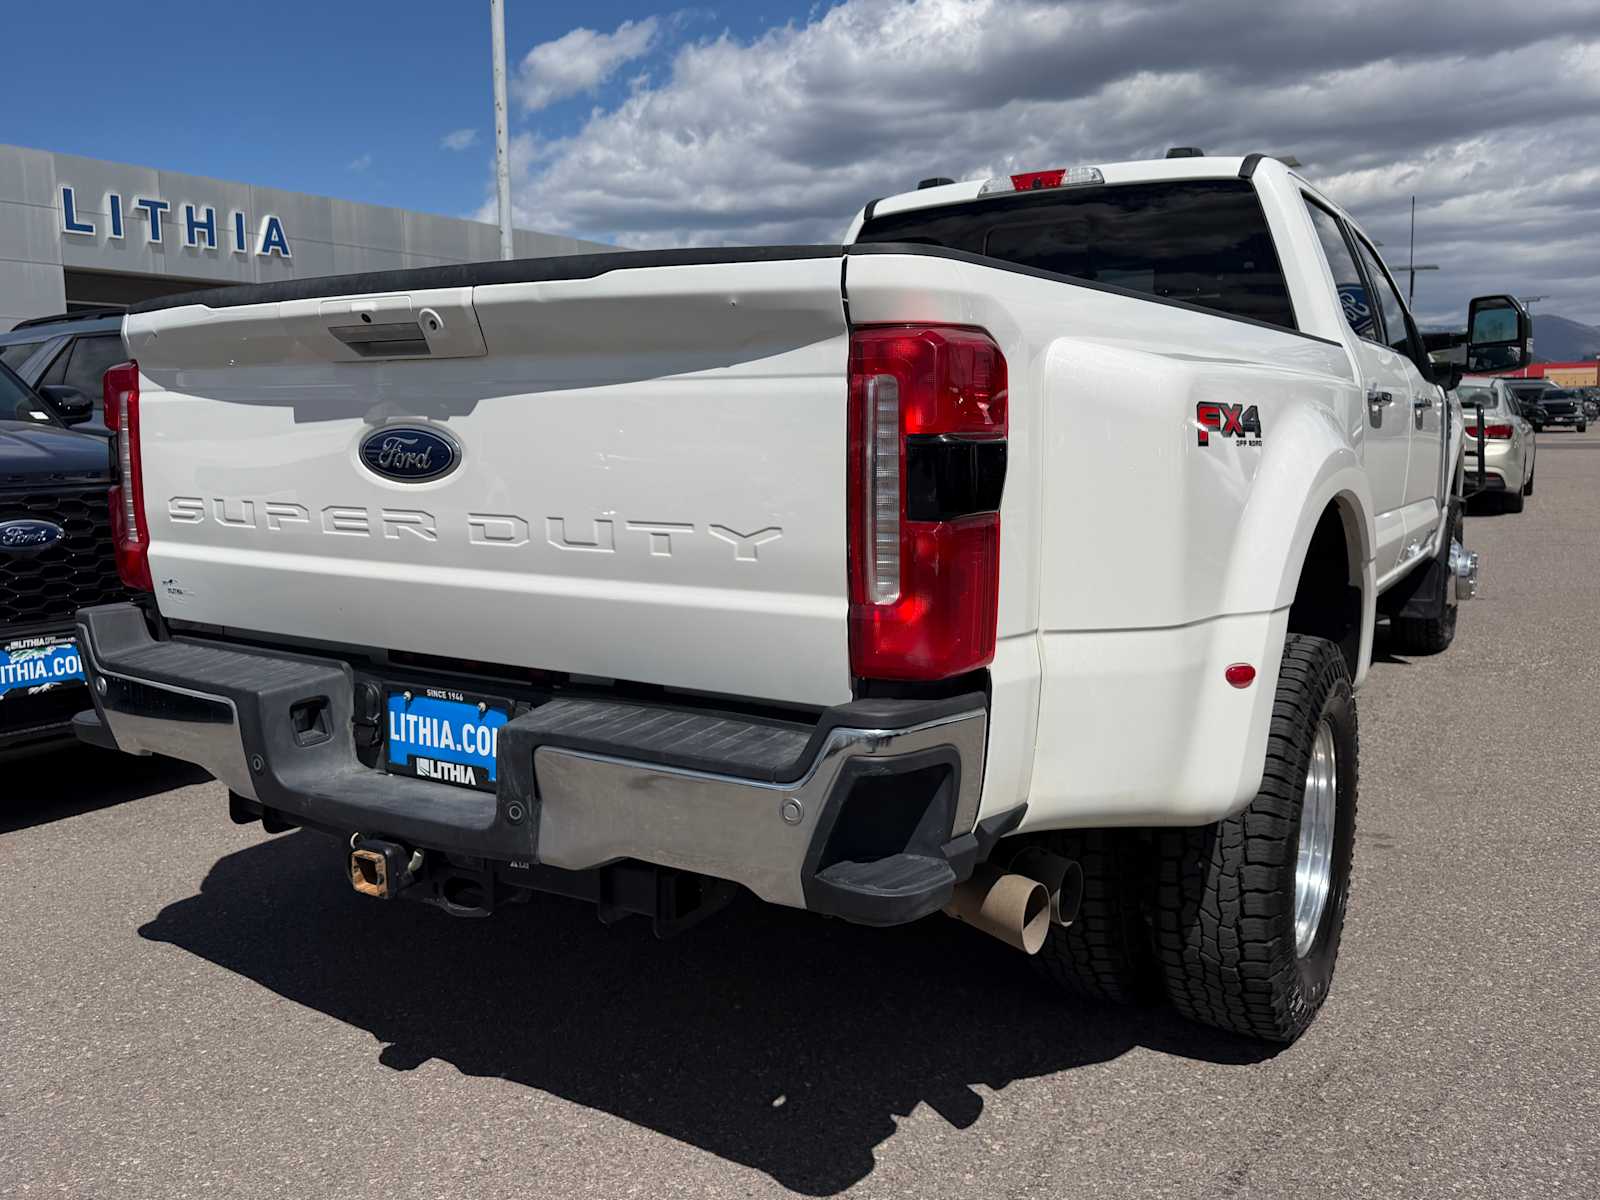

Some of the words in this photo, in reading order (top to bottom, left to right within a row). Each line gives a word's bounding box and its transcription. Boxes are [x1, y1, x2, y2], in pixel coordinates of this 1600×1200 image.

[60, 185, 292, 258] LITHIA
[1196, 401, 1262, 447] FX4
[378, 436, 432, 469] Ford
[2, 527, 47, 545] Ford
[168, 496, 438, 542] SUPER
[467, 512, 783, 562] DUTY
[0, 655, 83, 684] ITHIA.CO
[426, 689, 446, 698] SINCE
[448, 692, 464, 701] 1946
[430, 760, 476, 785] LITHIA
